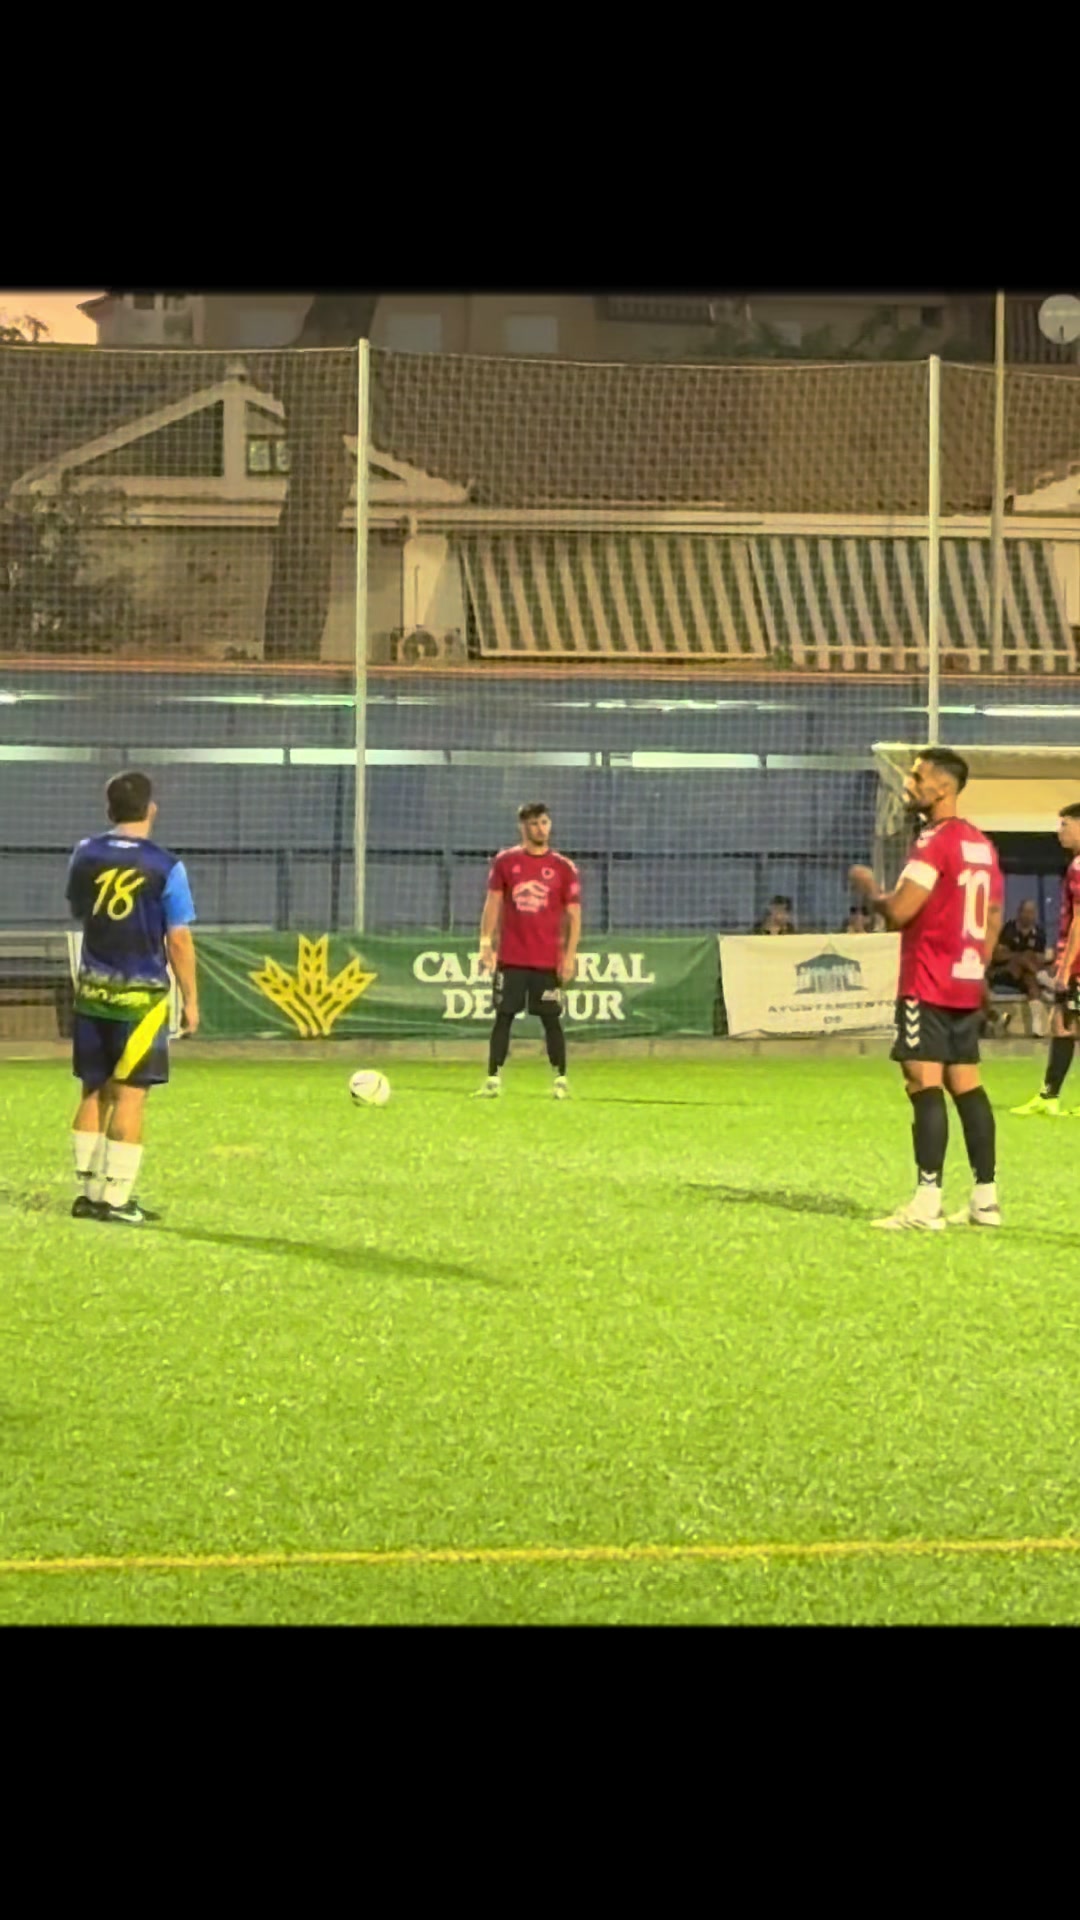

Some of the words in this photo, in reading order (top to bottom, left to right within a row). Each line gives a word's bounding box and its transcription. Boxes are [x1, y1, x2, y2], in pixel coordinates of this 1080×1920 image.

[92, 868, 145, 920] 18
[957, 868, 990, 940] 10
[442, 989, 527, 1020] DE
[560, 989, 625, 1020] UR
